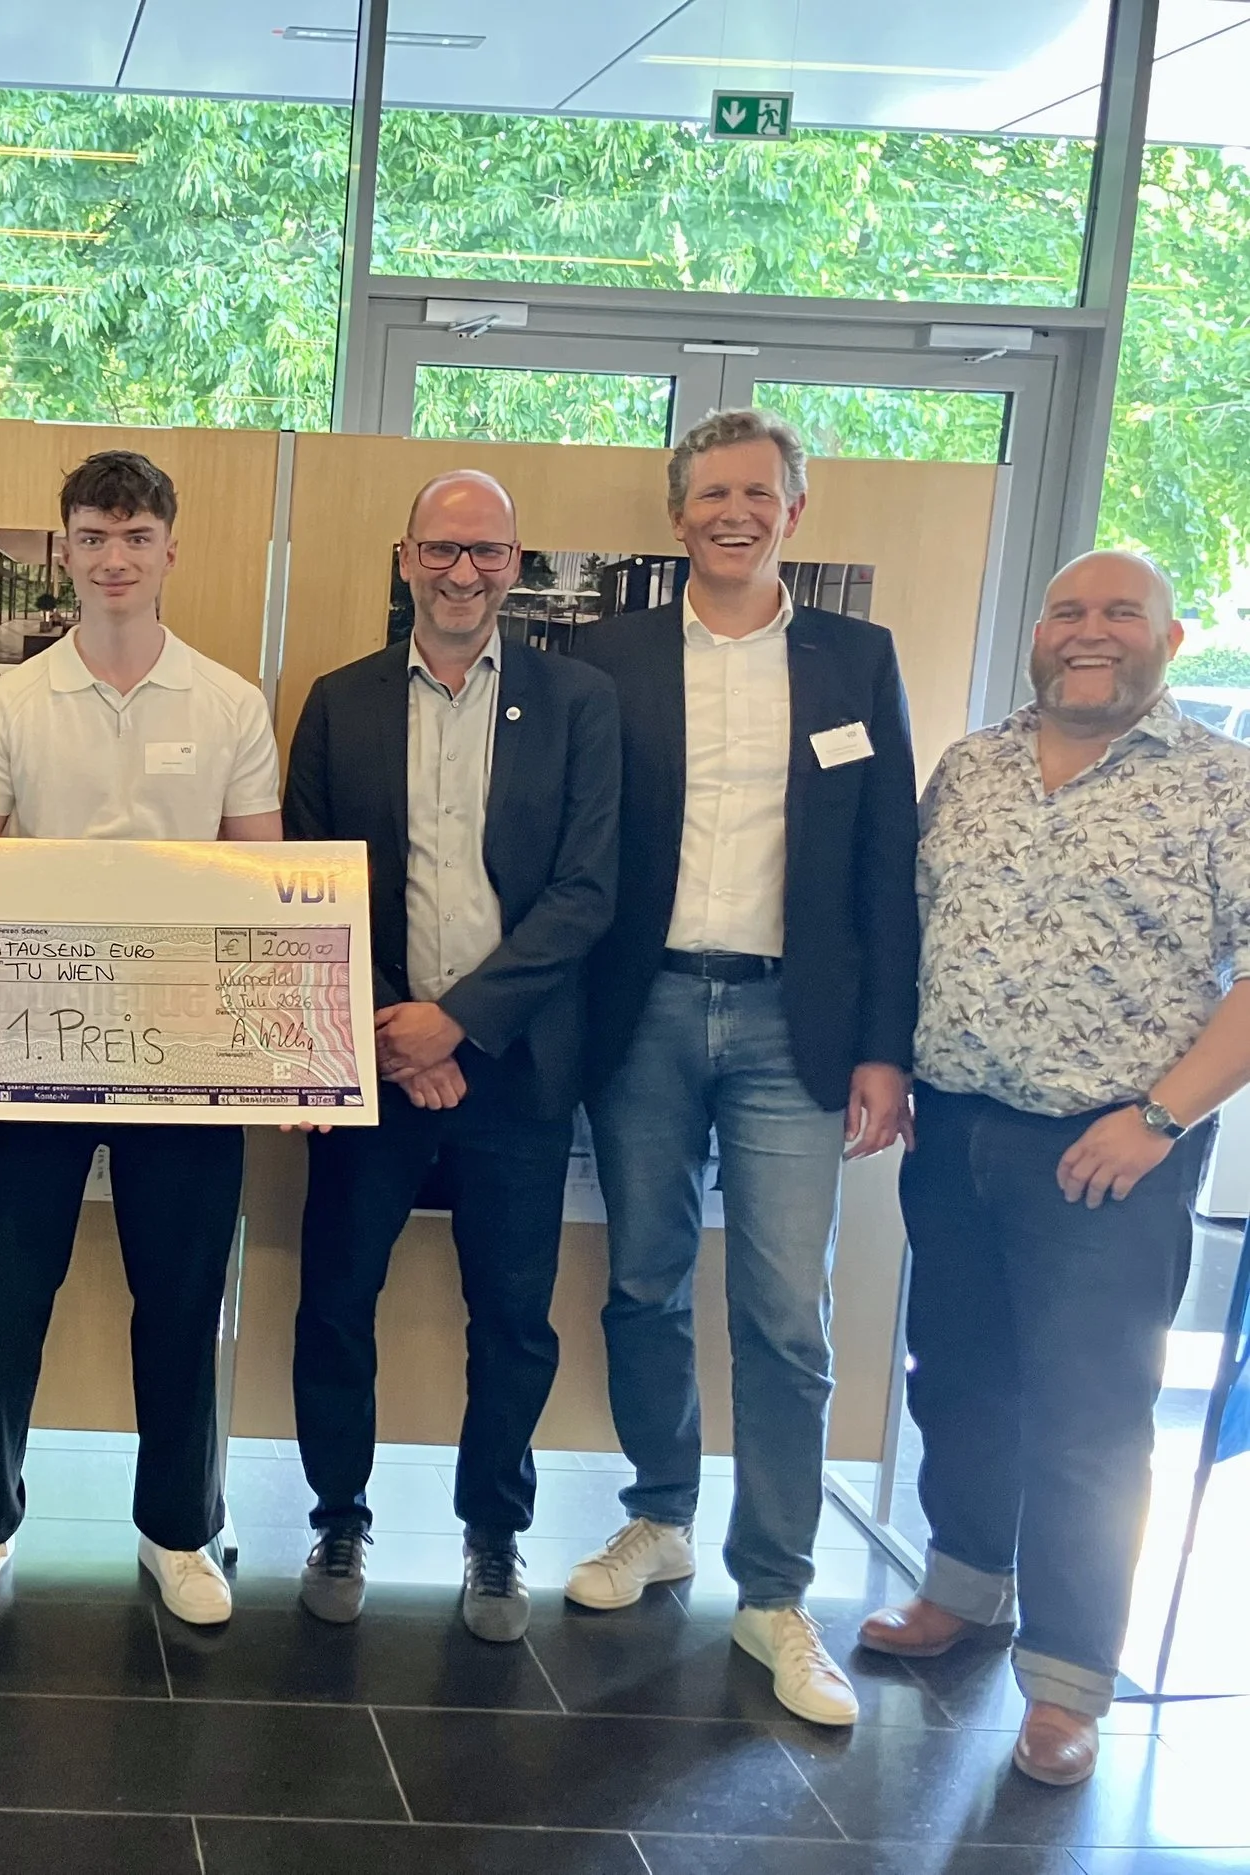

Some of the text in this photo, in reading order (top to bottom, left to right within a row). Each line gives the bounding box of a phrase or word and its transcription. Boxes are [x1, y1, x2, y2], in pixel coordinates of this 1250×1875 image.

[273, 871, 336, 904] VDI
[21, 927, 48, 935] Scheck
[109, 943, 155, 958] EURO
[4, 961, 115, 981] TU WIEN
[219, 967, 300, 991] Wuppertal
[7, 1008, 43, 1059] 1.
